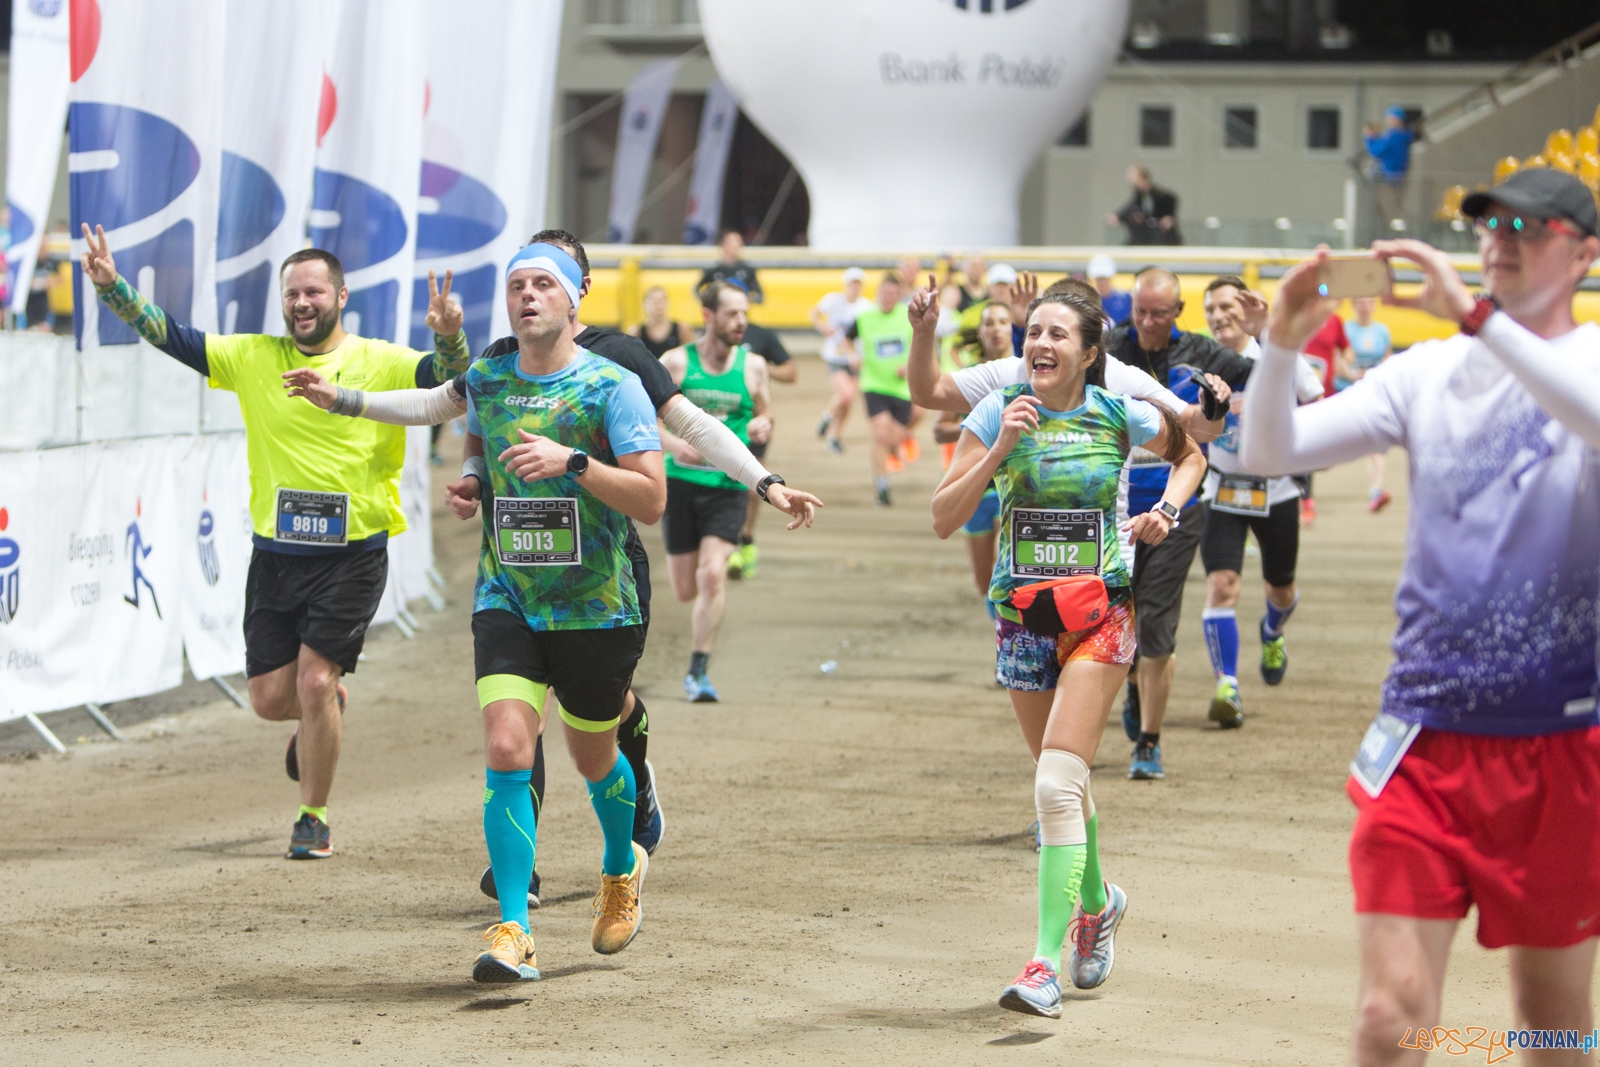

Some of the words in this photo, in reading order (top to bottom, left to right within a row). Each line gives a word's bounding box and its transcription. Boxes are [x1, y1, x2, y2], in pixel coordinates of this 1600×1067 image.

[879, 52, 967, 86] Bank
[1034, 431, 1093, 443] DIANA
[293, 515, 328, 534] 9819
[512, 531, 554, 551] 5013
[1034, 543, 1079, 564] 5012
